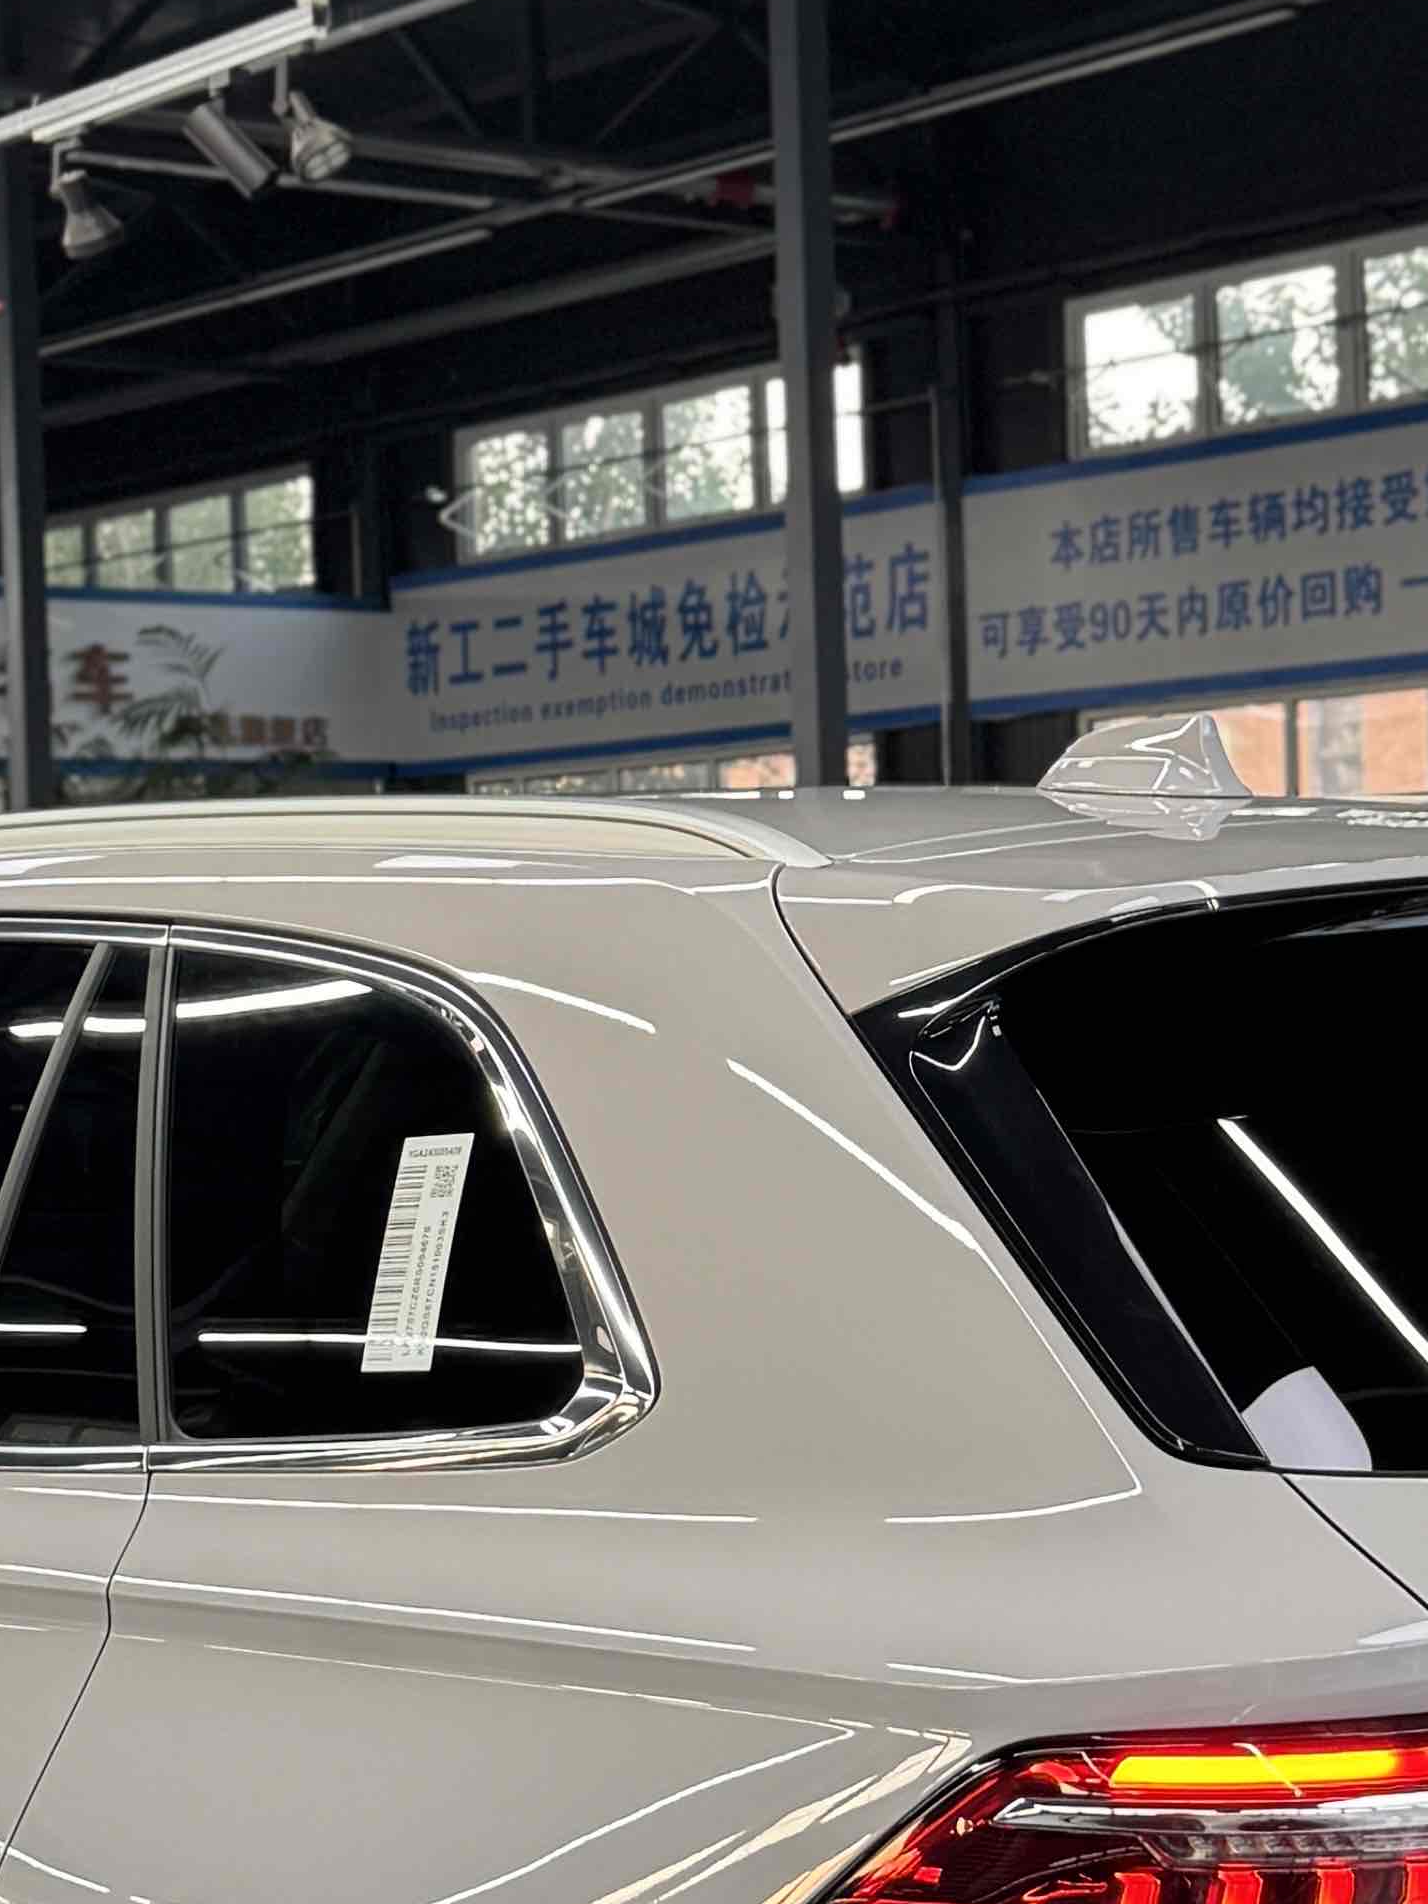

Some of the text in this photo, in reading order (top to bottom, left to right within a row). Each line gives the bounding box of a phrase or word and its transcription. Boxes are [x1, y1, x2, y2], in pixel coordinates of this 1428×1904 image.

[406, 541, 930, 696] 新工二手车城免检范店
[980, 564, 1383, 658] 可享受90天内原价回购
[541, 687, 653, 721] exemption
[661, 668, 792, 705] demonstrat
[846, 656, 904, 684] tore
